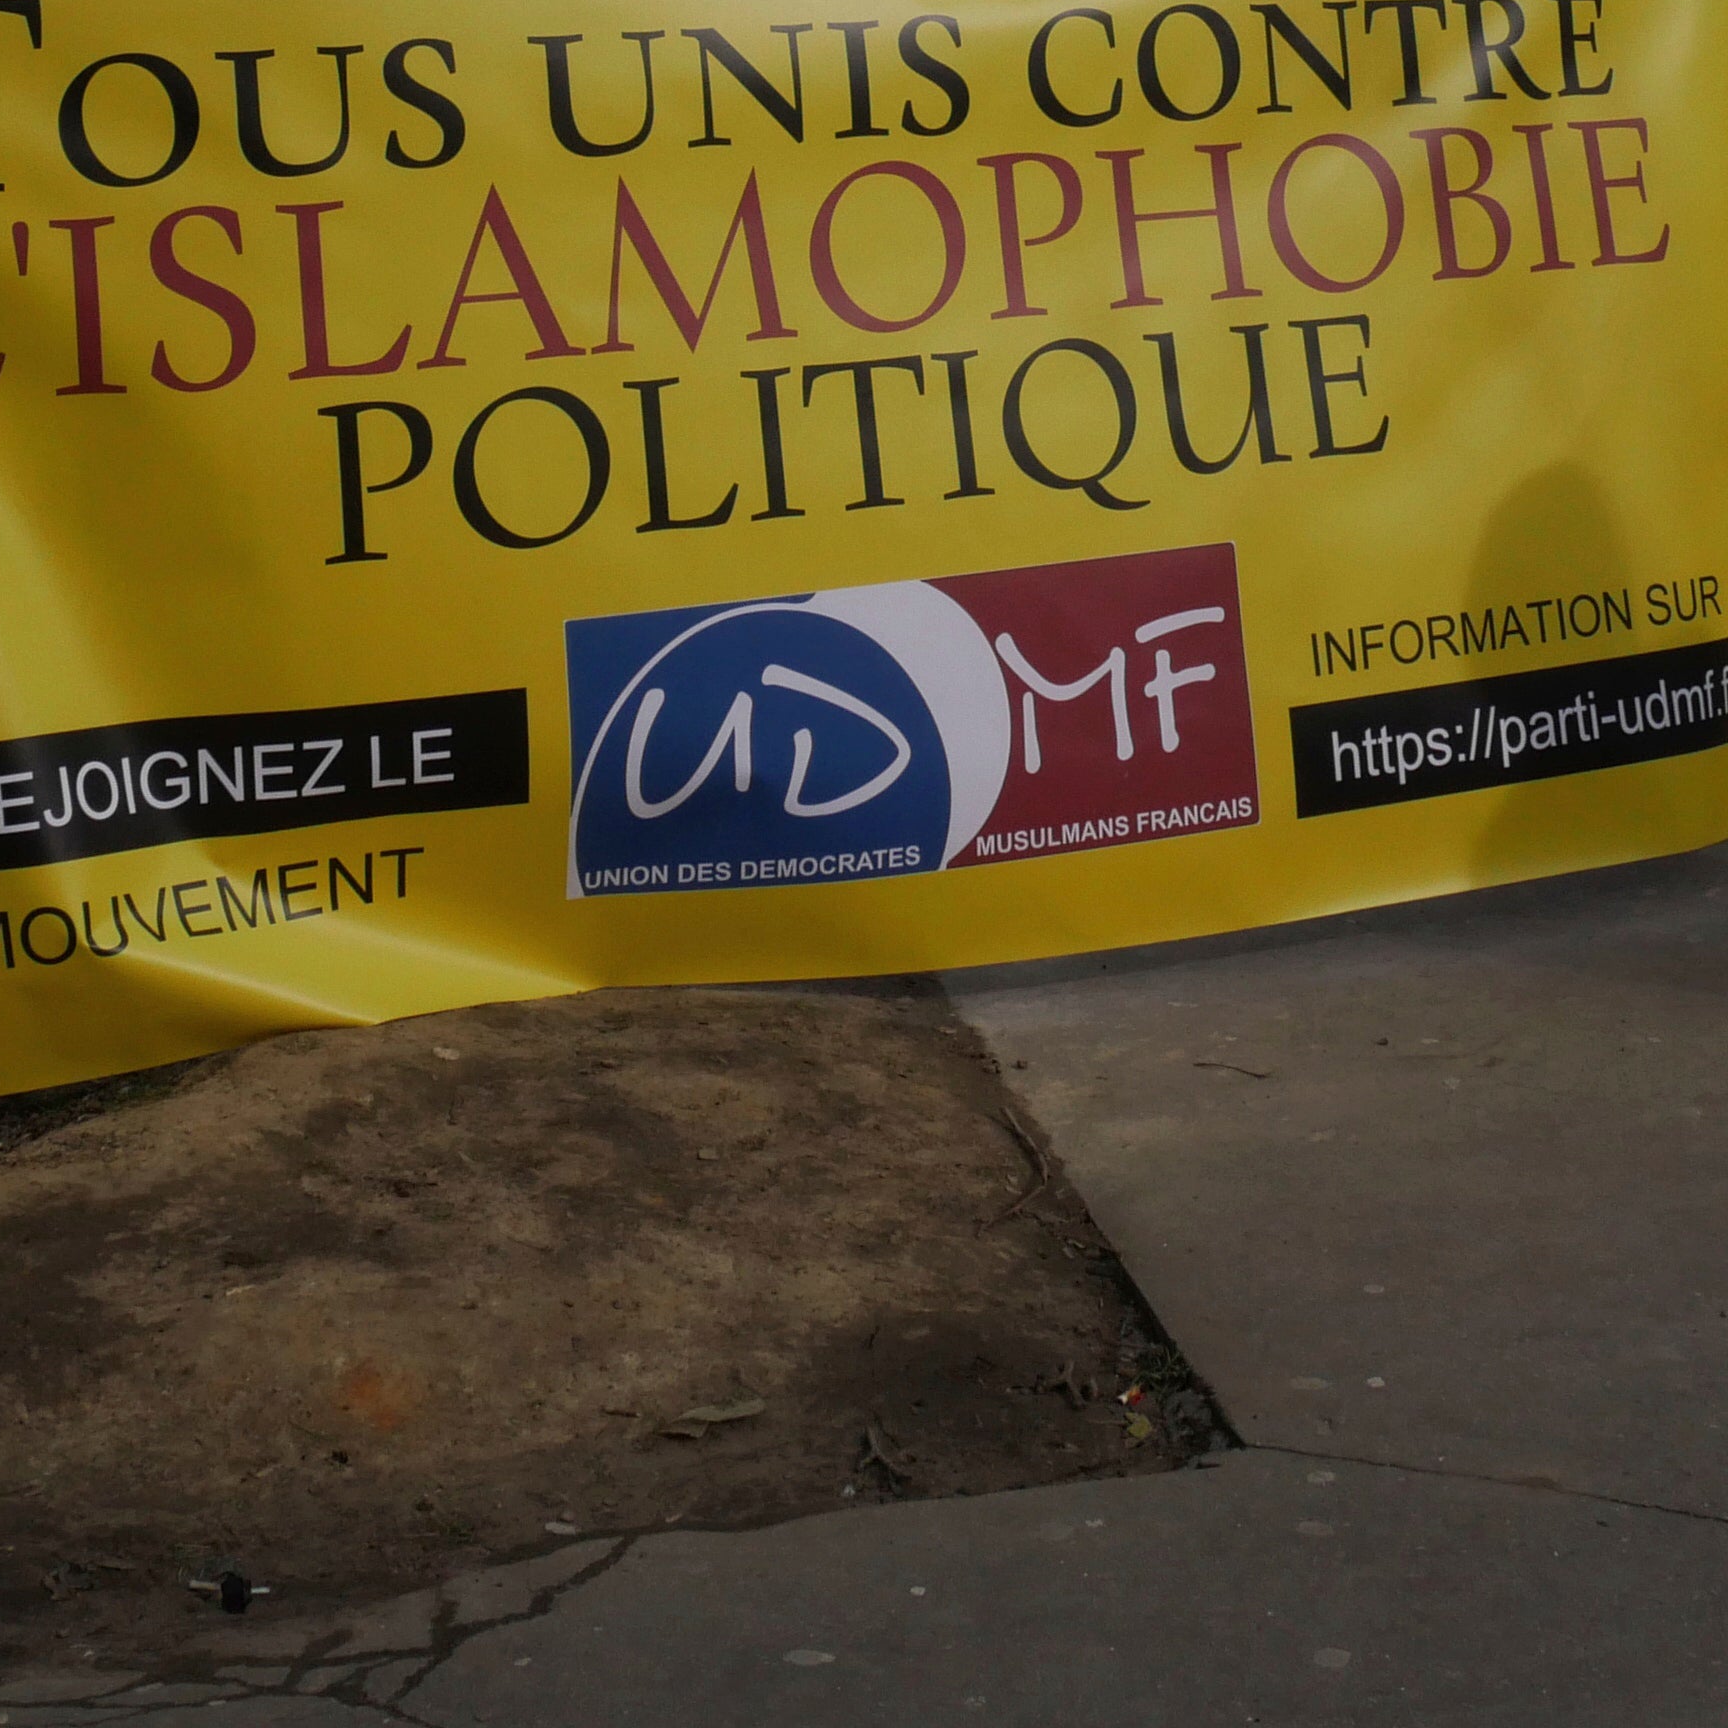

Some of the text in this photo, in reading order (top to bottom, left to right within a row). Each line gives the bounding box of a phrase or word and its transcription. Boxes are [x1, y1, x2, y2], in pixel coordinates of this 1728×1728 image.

[528, 13, 972, 160] UNIS
[318, 314, 1390, 565] POLITIQUE
[1310, 575, 1723, 677] INFORMATION SUR
[369, 726, 456, 789] LE
[583, 844, 921, 890] UNION DES DEMOCRATES
[975, 795, 1253, 857] MUSULMANS FRANCAIS
